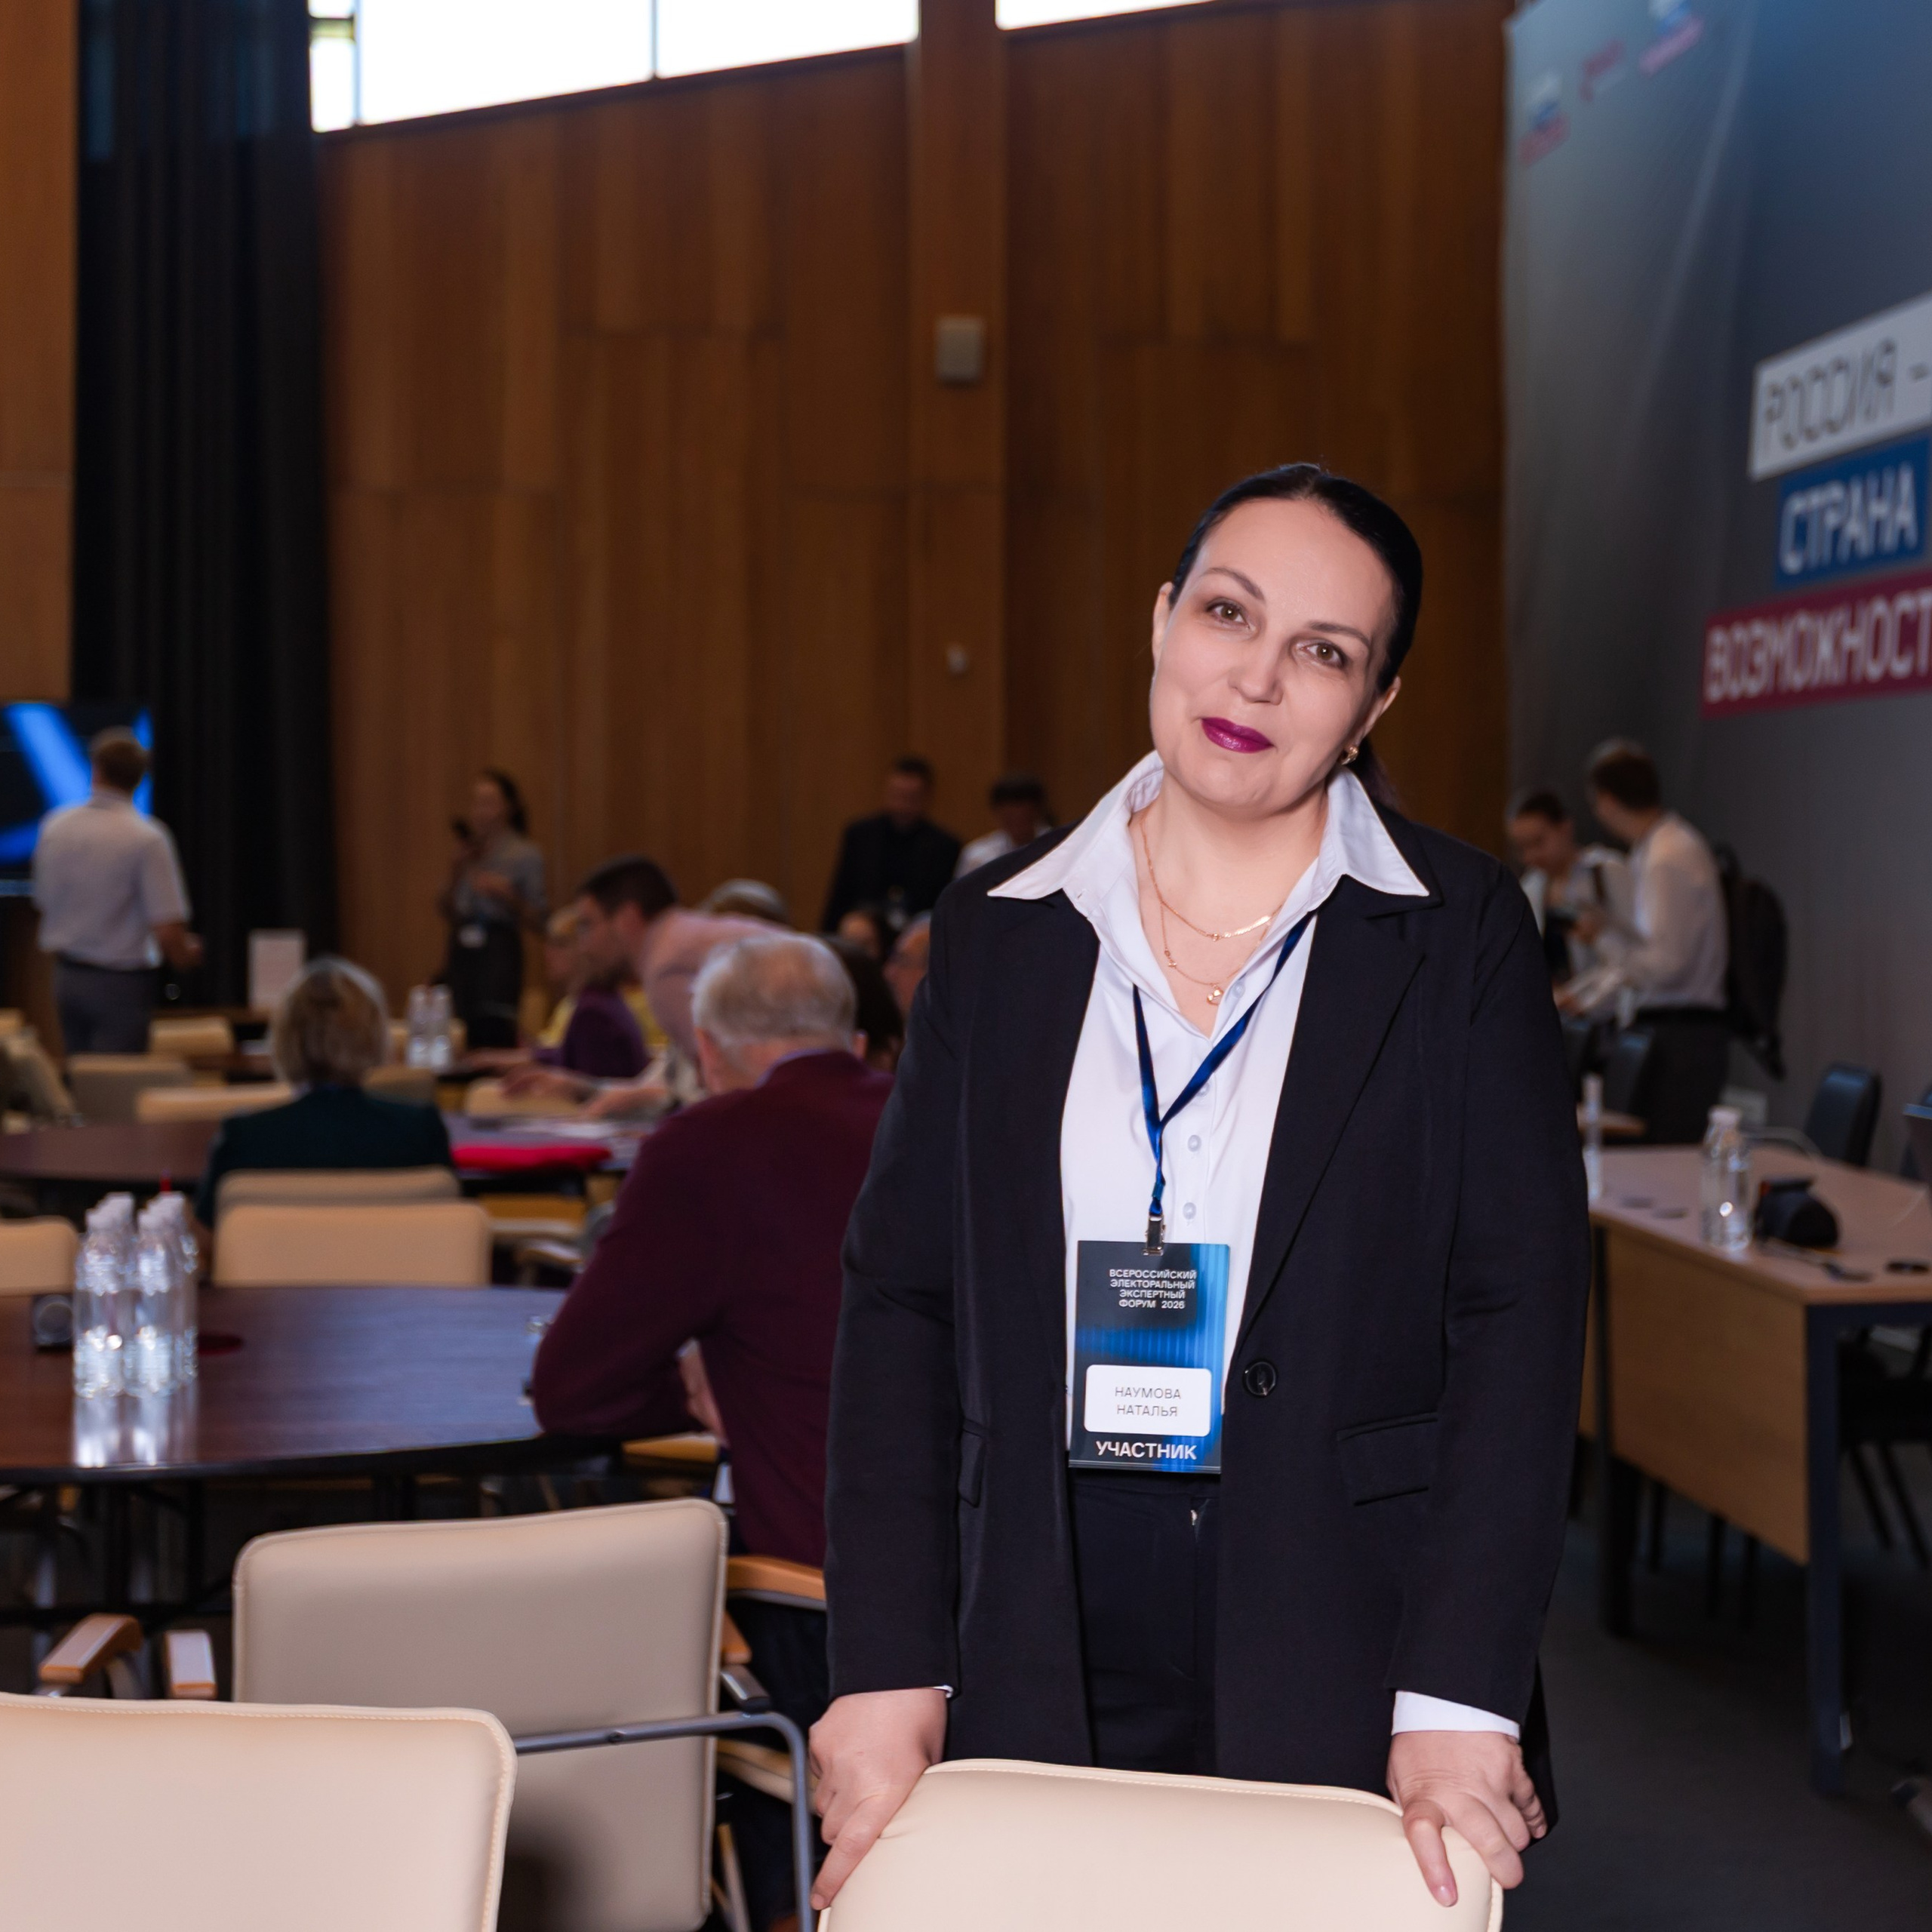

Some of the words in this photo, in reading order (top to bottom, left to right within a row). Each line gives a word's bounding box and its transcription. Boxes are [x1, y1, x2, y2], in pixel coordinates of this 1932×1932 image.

[1764, 337, 1897, 453] РОССИЯ
[1780, 462, 1918, 574] СТРАНА
[1109, 1269, 1197, 1279] ВСЕРОССИЙСКИЙ
[1110, 1278, 1196, 1290] ЭЛЕКТОРАЛЬНЫЙ
[1119, 1288, 1186, 1300] ЭКСПЕРТНЫЙ
[1118, 1299, 1156, 1309] ФОРУМ
[1161, 1300, 1185, 1309] 2026
[1115, 1386, 1181, 1399] НАУМОВА
[1117, 1404, 1178, 1417] НАТАЛЬЯ
[1096, 1440, 1197, 1460] УЧАСТНИК
